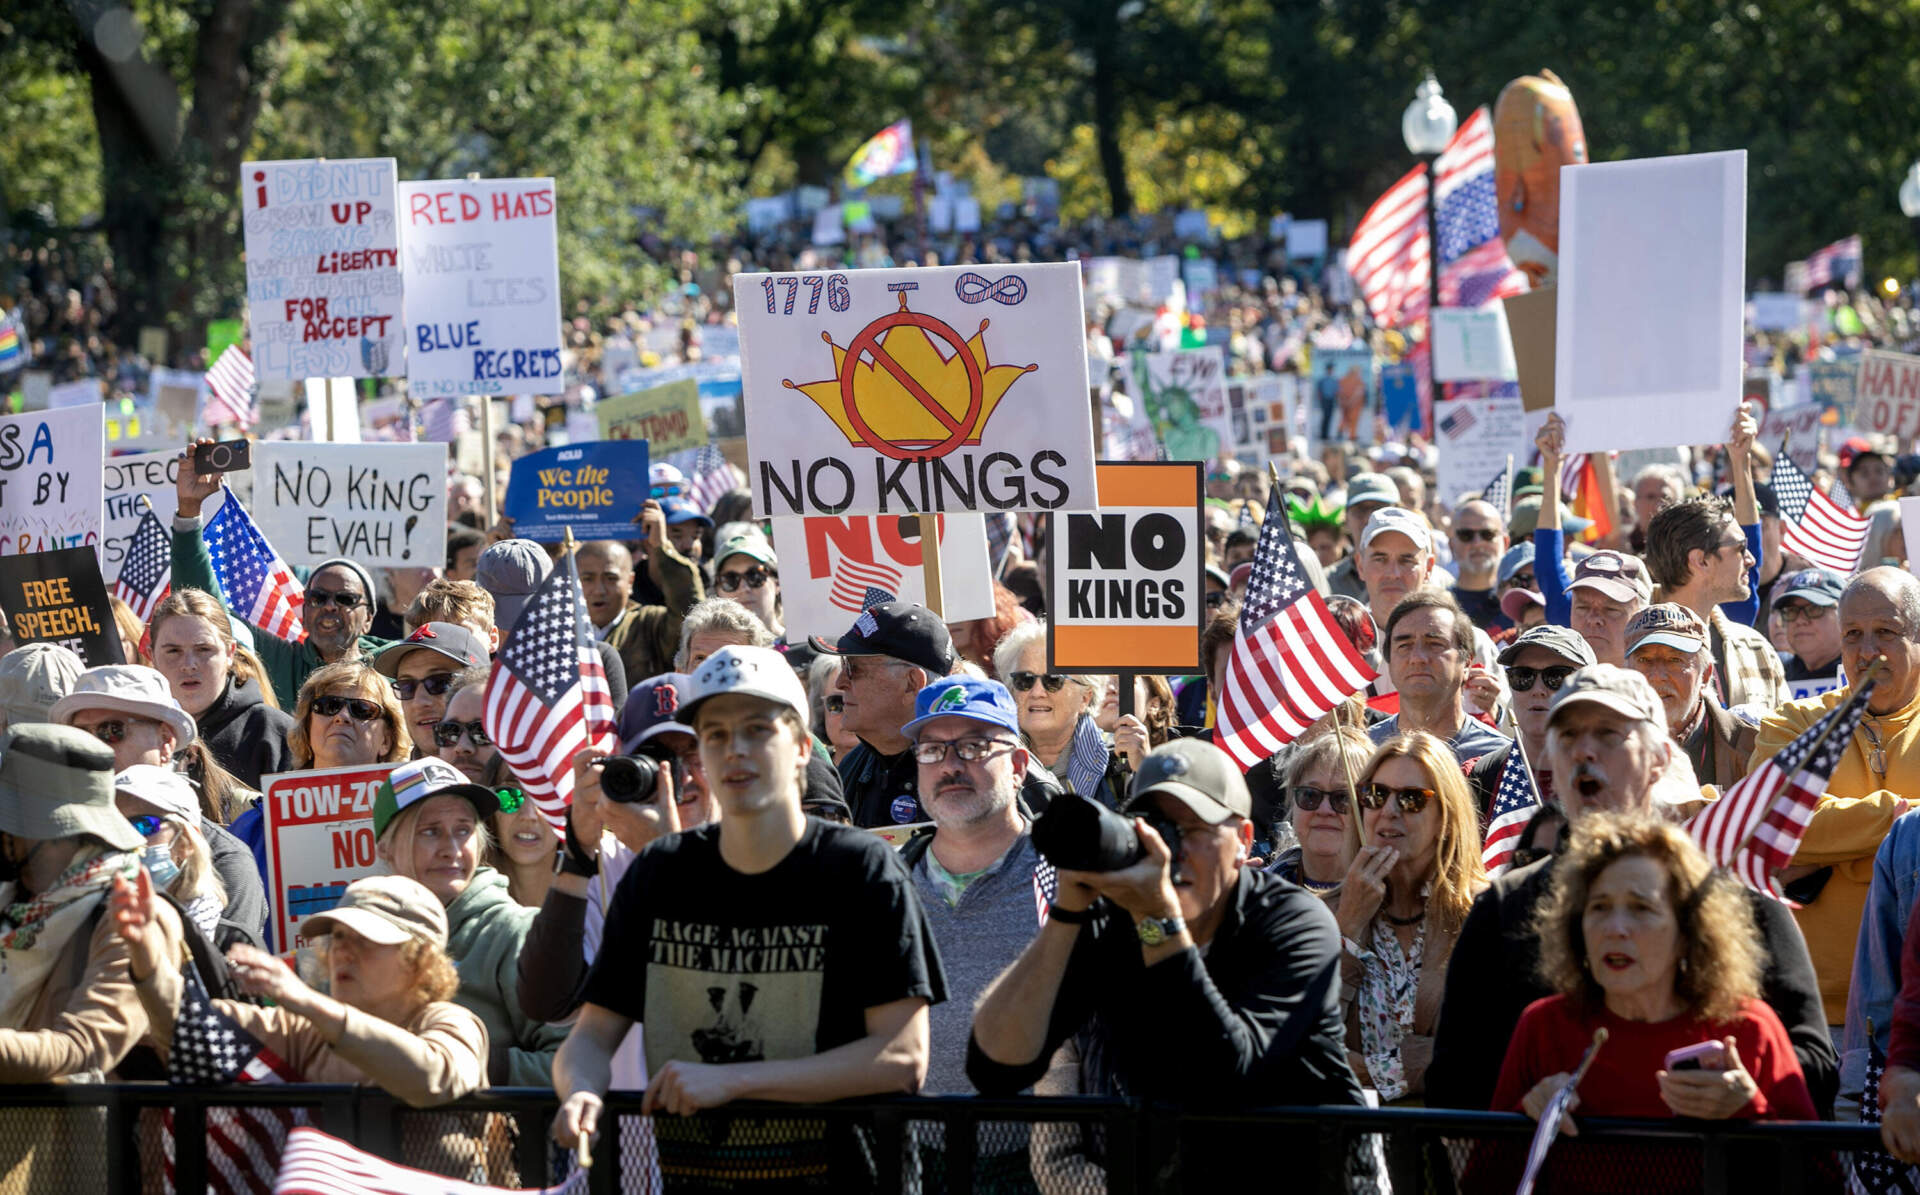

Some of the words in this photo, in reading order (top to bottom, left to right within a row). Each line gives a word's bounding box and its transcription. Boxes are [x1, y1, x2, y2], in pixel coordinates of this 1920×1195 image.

[331, 202, 372, 224] UP
[411, 192, 481, 224] RED
[492, 188, 555, 221] HATS
[411, 243, 493, 275] WHITE
[285, 297, 329, 321] FOR
[331, 295, 378, 317] ALL
[467, 277, 548, 308] LIES
[762, 274, 850, 314] 1776
[258, 321, 296, 343] TO
[303, 315, 393, 342] ACCEPT
[417, 320, 482, 352] BLUE
[474, 348, 562, 381] REGRETS
[1873, 401, 1920, 437] OF
[33, 472, 70, 506] BY
[275, 461, 331, 508] NO
[538, 466, 573, 488] We
[575, 464, 610, 486] the
[760, 457, 855, 515] NO
[877, 450, 1070, 512] KINGS
[104, 493, 152, 520] THE
[537, 486, 614, 511] People
[308, 515, 419, 561] EVAH!
[803, 513, 945, 579] NO
[1067, 513, 1186, 571] NO
[22, 577, 75, 608] FREE
[1068, 578, 1186, 620] KINGS
[14, 605, 101, 640] SPEECH,
[653, 684, 679, 717] B
[332, 828, 376, 869] NO
[652, 918, 719, 945] RAGE
[725, 924, 829, 948] AGAINST
[650, 940, 701, 970] THE
[707, 947, 825, 973] MACHINE
